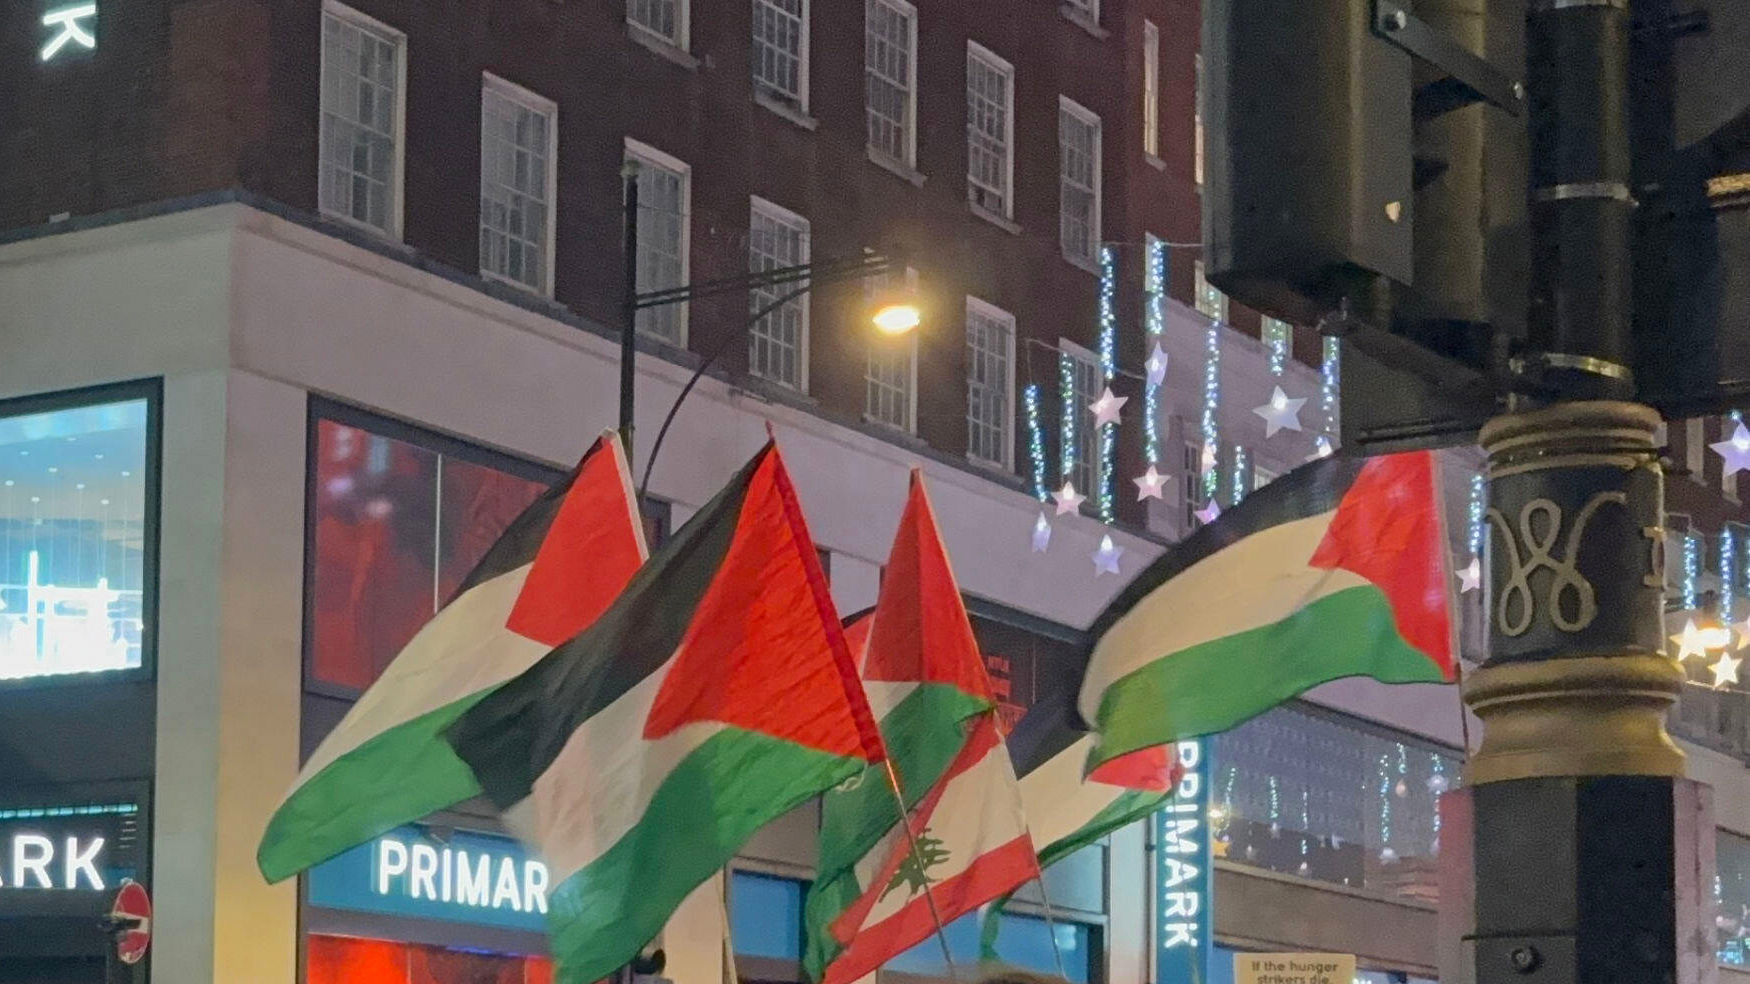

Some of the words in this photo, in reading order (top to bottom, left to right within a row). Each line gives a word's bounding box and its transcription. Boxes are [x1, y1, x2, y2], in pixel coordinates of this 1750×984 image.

[378, 839, 550, 914] PRIMAR
[1251, 961, 1260, 972] If
[1264, 961, 1285, 972] the
[1290, 960, 1338, 974] hunger
[1257, 974, 1306, 984] strikers
